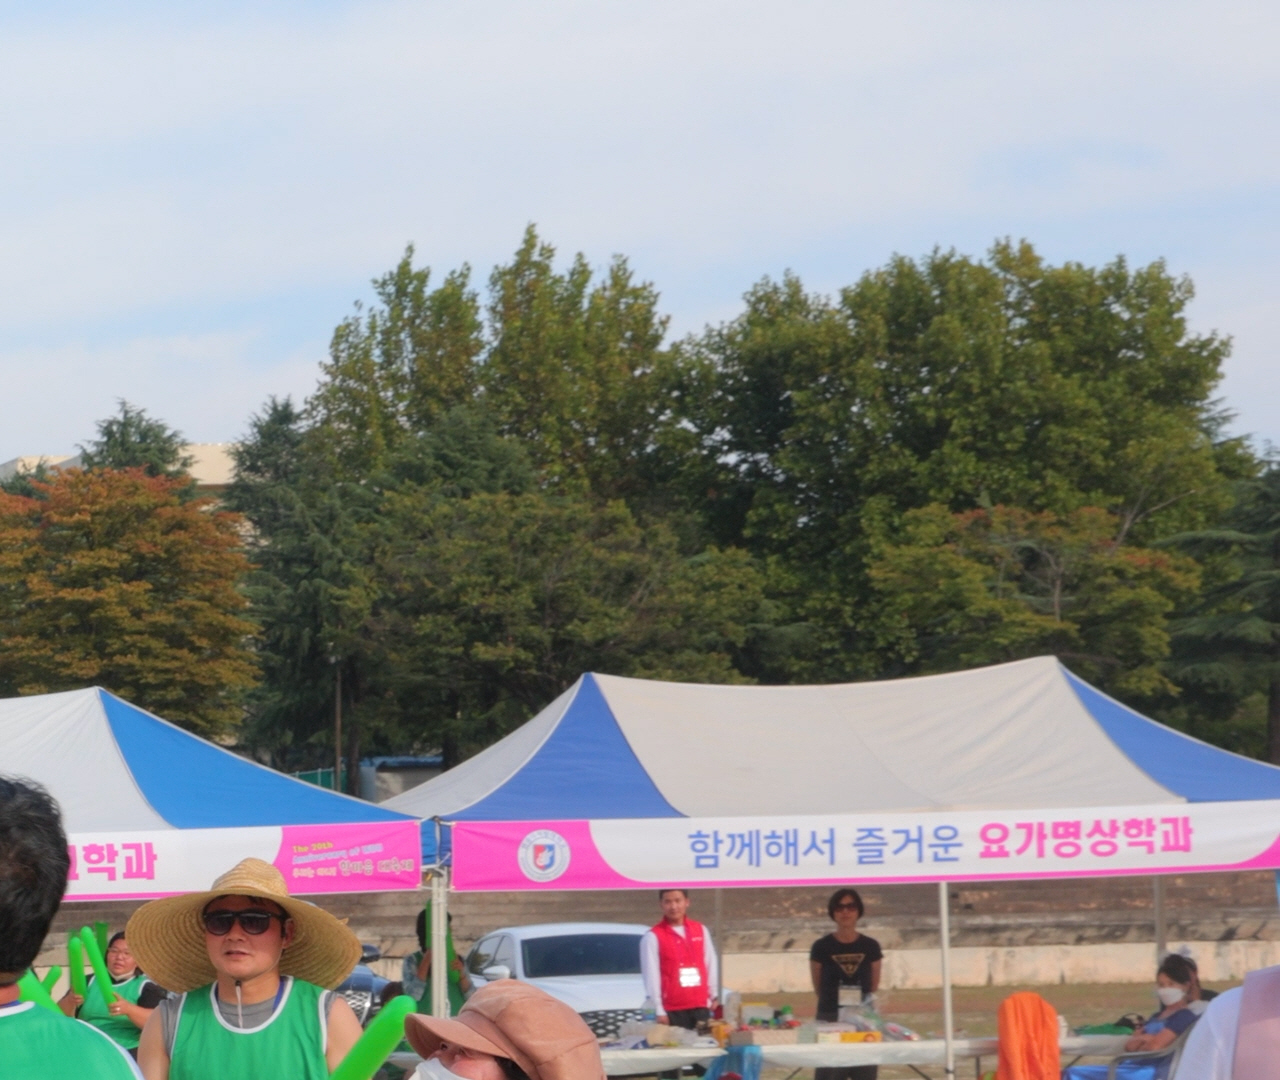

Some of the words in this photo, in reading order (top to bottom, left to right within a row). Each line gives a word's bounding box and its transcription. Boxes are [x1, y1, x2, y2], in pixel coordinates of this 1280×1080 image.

[688, 828, 836, 870] 함께해서
[852, 825, 964, 866] 즐거운
[978, 816, 1195, 860] 요가명상학과
